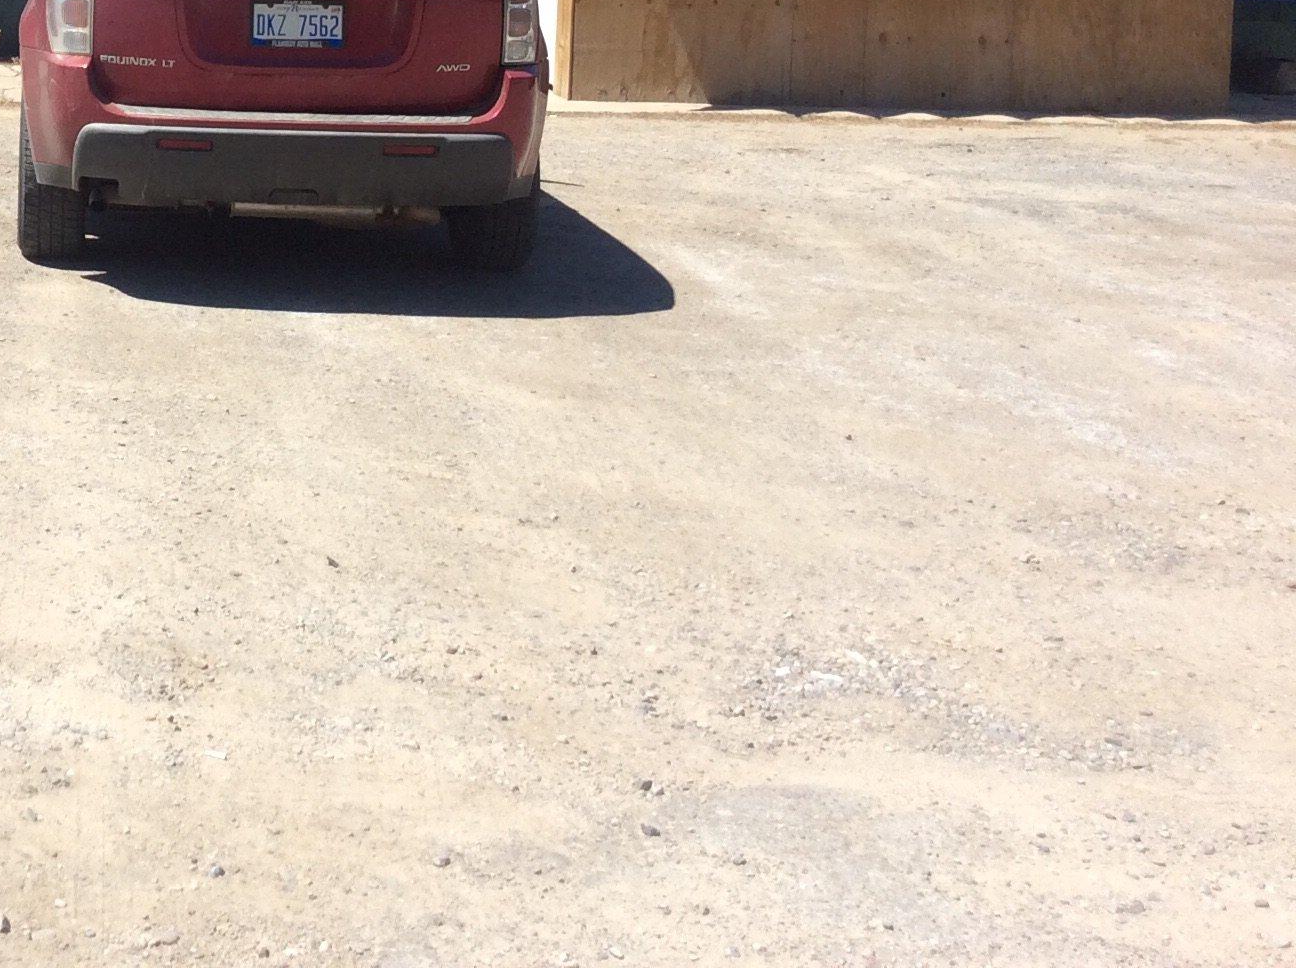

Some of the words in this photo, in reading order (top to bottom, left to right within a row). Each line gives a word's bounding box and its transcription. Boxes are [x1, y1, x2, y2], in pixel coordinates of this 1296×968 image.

[256, 13, 286, 36] DKZ
[298, 14, 339, 38] 7562
[162, 59, 176, 68] LT
[436, 63, 471, 72] AWD
